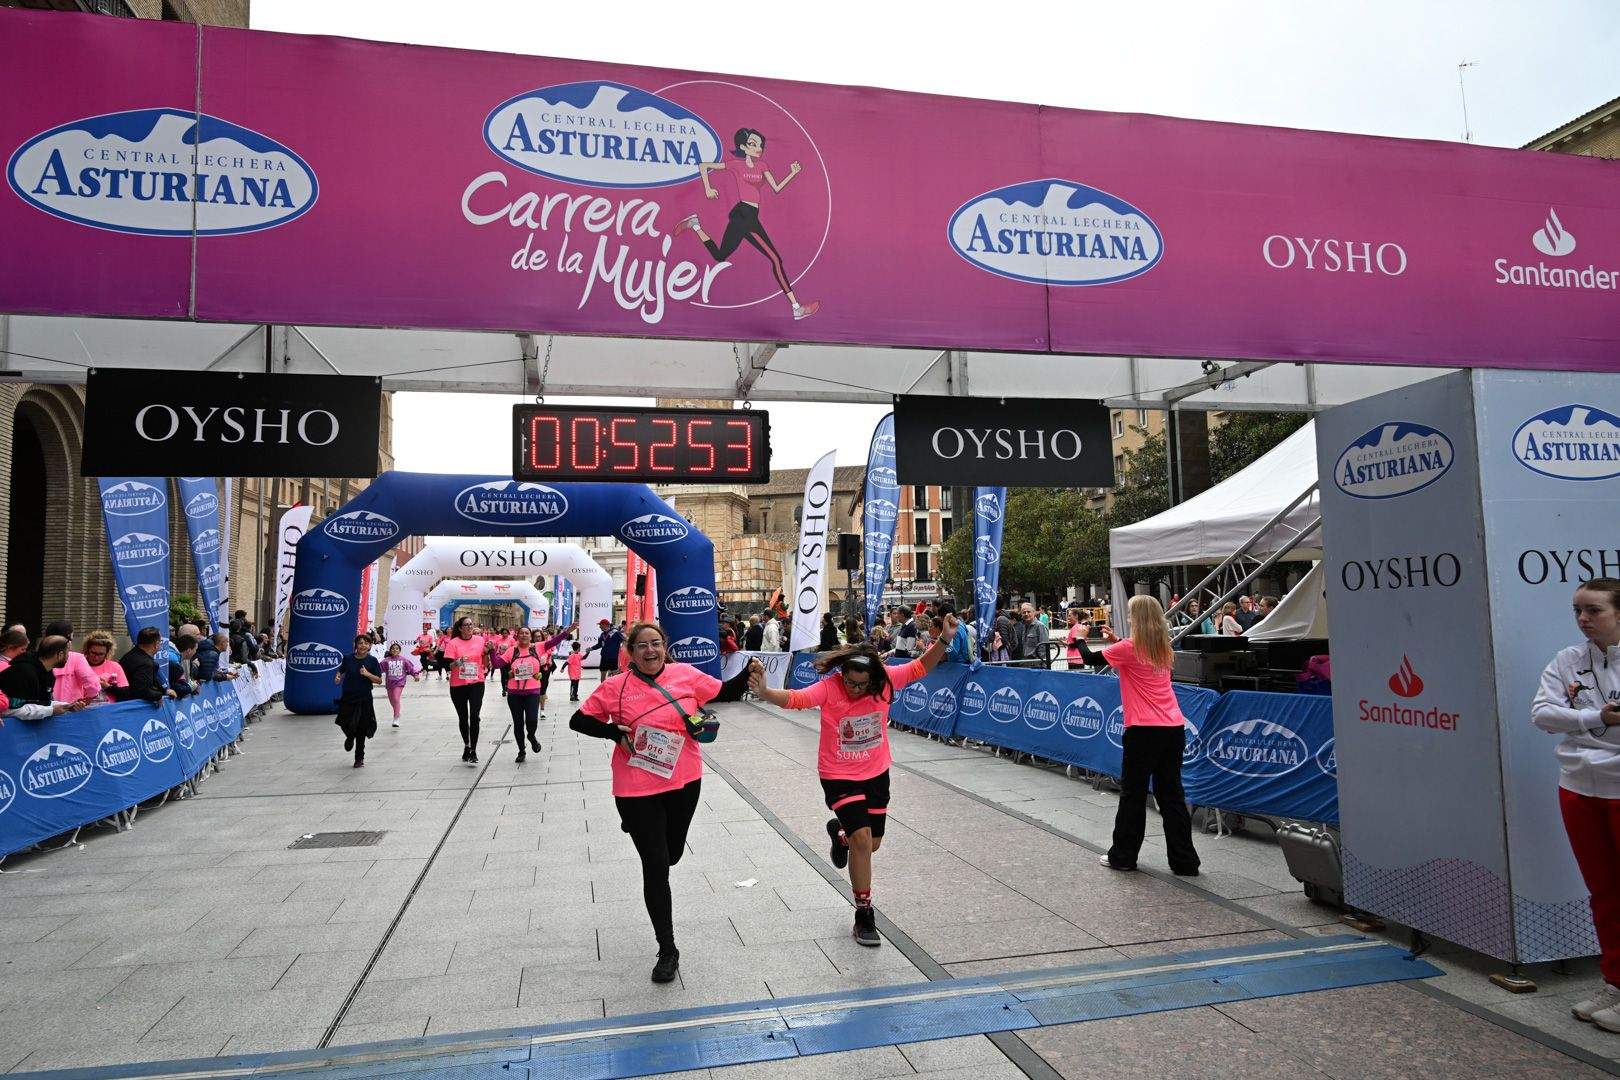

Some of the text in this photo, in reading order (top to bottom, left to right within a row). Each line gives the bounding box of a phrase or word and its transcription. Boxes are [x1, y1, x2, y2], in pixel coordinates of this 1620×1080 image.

[541, 112, 698, 135] CENTRAL LECHERA
[502, 112, 703, 166] ASTURIANA
[84, 148, 286, 171] CENTRAL LECHERA
[32, 148, 295, 208] ASTURIANA
[461, 171, 660, 237] Carrera
[1000, 213, 1141, 231] CENTRAL LECHERA
[966, 213, 1149, 261] ASTURIANA
[1262, 235, 1408, 276] OYSHO
[511, 233, 732, 324] de la Mujer
[1494, 258, 1620, 290] Santander
[135, 404, 340, 446] OYSHO
[932, 427, 1082, 460] OYSHO
[1357, 439, 1439, 461] CENTRAL LECHERA
[1342, 450, 1446, 487] ASTURIANA
[463, 493, 560, 514] ASTURIANA
[328, 521, 393, 536] ASTURIANA
[626, 525, 684, 538] ASTURIANA
[460, 549, 548, 567] OYSHO
[797, 481, 829, 615] OYSHO
[405, 569, 434, 577] OYSHO
[1341, 553, 1461, 592] OYSHO
[293, 600, 346, 613] ASTURIANA
[289, 652, 340, 666] ASTURIANA
[1063, 709, 1100, 731] ASTURIANA
[1359, 700, 1459, 731] Santander
[836, 750, 871, 760] SUMA
[1212, 737, 1299, 766] ASTURIANA
[28, 761, 90, 791] ASTURIANA
